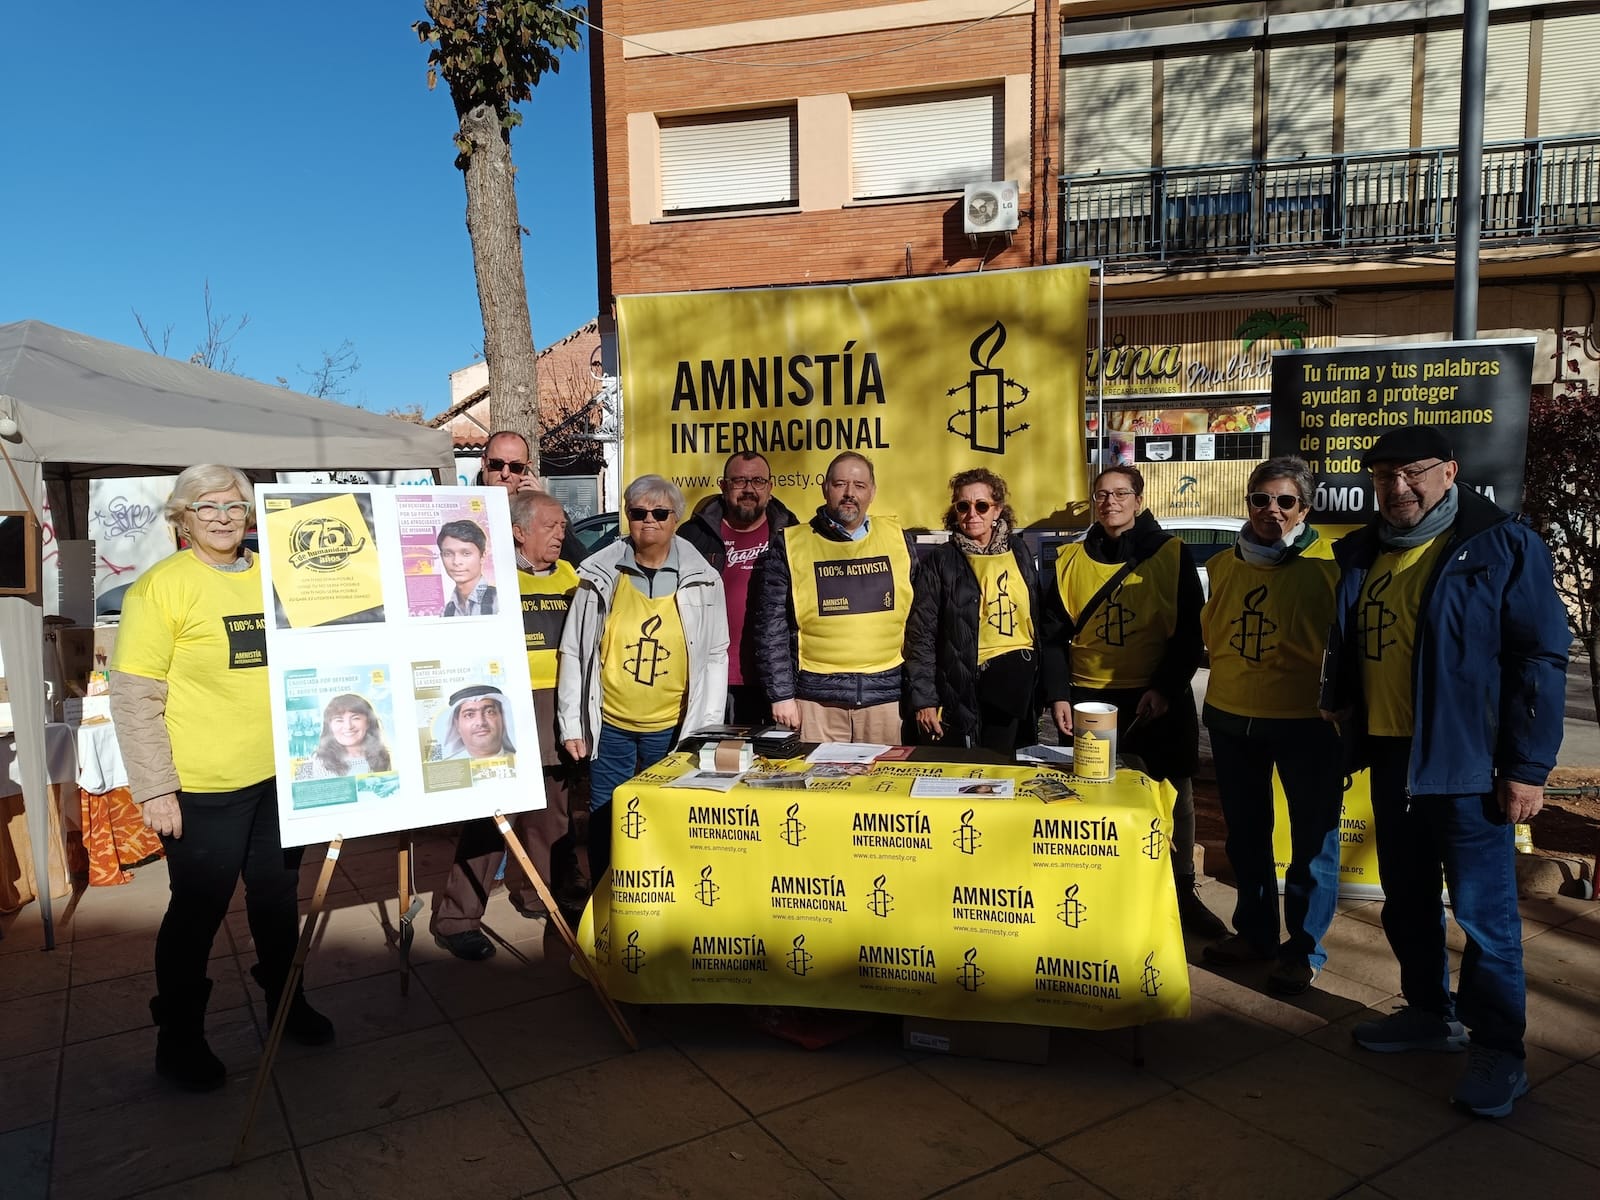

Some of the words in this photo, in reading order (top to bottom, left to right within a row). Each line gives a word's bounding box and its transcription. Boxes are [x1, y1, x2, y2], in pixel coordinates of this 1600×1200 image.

[671, 341, 886, 411] AMNISTÍA
[1303, 364, 1321, 382] Tu
[1326, 363, 1370, 382] firma
[1376, 365, 1387, 383] y
[1391, 361, 1418, 379] tus
[1423, 358, 1501, 381] palabras
[1140, 387, 1148, 395] DE
[1301, 387, 1361, 408] ayudan
[1367, 389, 1377, 403] a
[1383, 385, 1459, 406] proteger
[1301, 411, 1324, 429] los
[1329, 408, 1408, 428] derechos
[1414, 408, 1494, 425] humanos
[671, 417, 890, 454] INTERNACIONAL
[1300, 435, 1320, 452] de
[1325, 457, 1361, 475] todo
[1313, 482, 1364, 513] ÓMO
[301, 521, 346, 549] 75
[297, 554, 307, 562] de
[308, 547, 349, 558] humanidad
[319, 555, 341, 564] años
[818, 565, 845, 577] 100%
[846, 561, 889, 576] ACTIVISTA
[541, 599, 568, 611] ACTIVIS
[822, 596, 849, 607] AMNISTÍA
[228, 620, 255, 632] 100%
[234, 649, 262, 660] AMNISTÍA
[689, 804, 760, 827] AMNISTÍA
[853, 810, 931, 832] AMNISTÍA
[1033, 816, 1118, 841] AMNISTÍA
[1340, 819, 1366, 830] TIMAS
[689, 828, 762, 842] INTERNACIONAL
[853, 834, 934, 850] INTERNACIONAL
[690, 843, 748, 854] www.es.amnesty.org
[1033, 842, 1120, 857] INTERNACIONAL
[853, 852, 917, 863] www.es.amnesty.org
[1033, 861, 1102, 871] www.es.amnesty.org
[771, 874, 846, 897] AMNISTÍA
[772, 896, 848, 912] INTERNACIONAL
[953, 885, 1034, 909] AMNISTÍA
[772, 913, 833, 924] www.es.amnesty.org
[953, 907, 1036, 924] INTERNACIONAL
[953, 925, 1019, 937] www.es.amnesty.org
[692, 934, 767, 957] AMNISTÍA
[692, 958, 768, 972] INTERNACIONAL
[859, 944, 936, 969] AMNISTÍA
[859, 966, 938, 985] INTERNACIONAL
[1035, 957, 1120, 985] AMNISTÍA
[1035, 979, 1121, 1001] INTERNACIONAL
